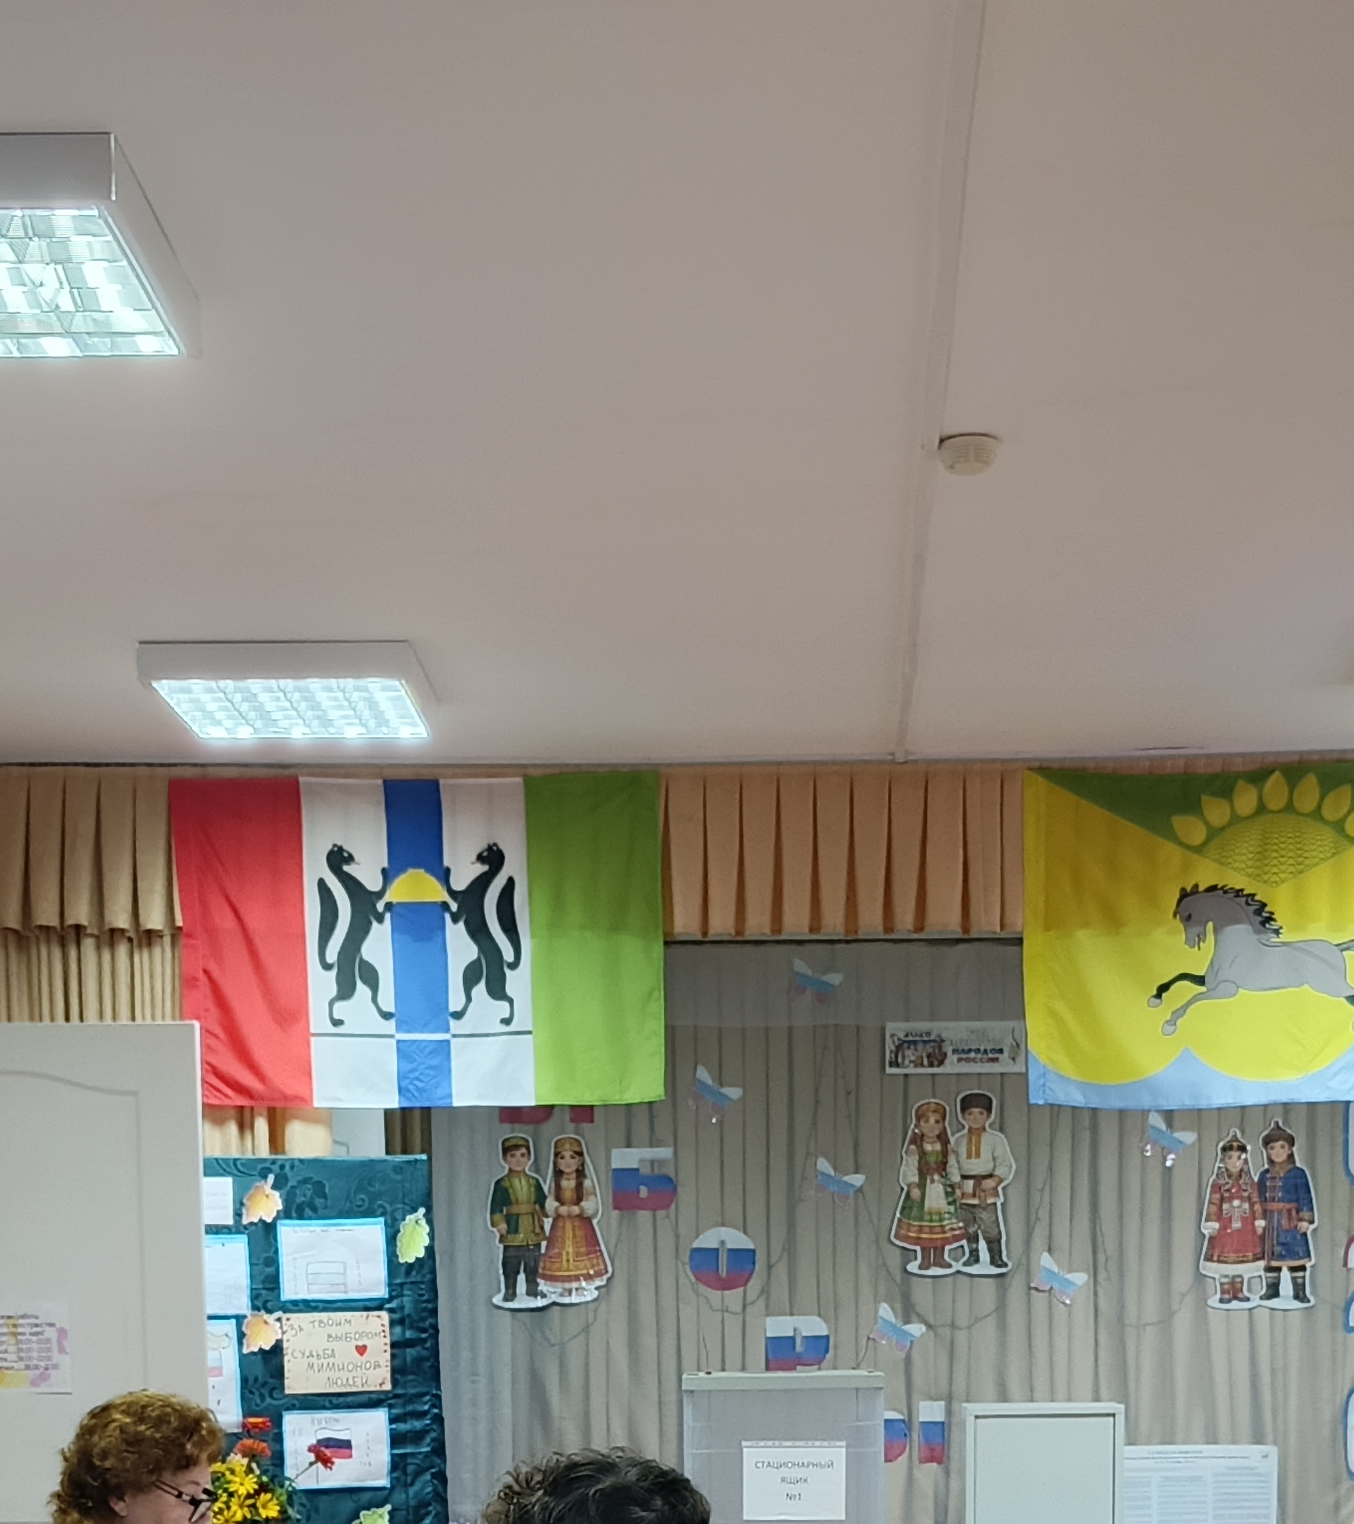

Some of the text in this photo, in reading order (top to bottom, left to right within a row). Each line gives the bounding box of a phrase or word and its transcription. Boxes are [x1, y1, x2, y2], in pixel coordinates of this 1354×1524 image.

[288, 1318, 352, 1337] ЗА ТВОИМ
[326, 1331, 382, 1343] ВЫБОРОМ
[291, 1348, 336, 1361] СУДЬБА
[325, 1373, 369, 1389] ЛЮДЕЙ
[754, 1459, 834, 1470] СТАЦИОНАРНЫЙ
[780, 1476, 809, 1485] ЯЩИК
[785, 1492, 801, 1501] №1
